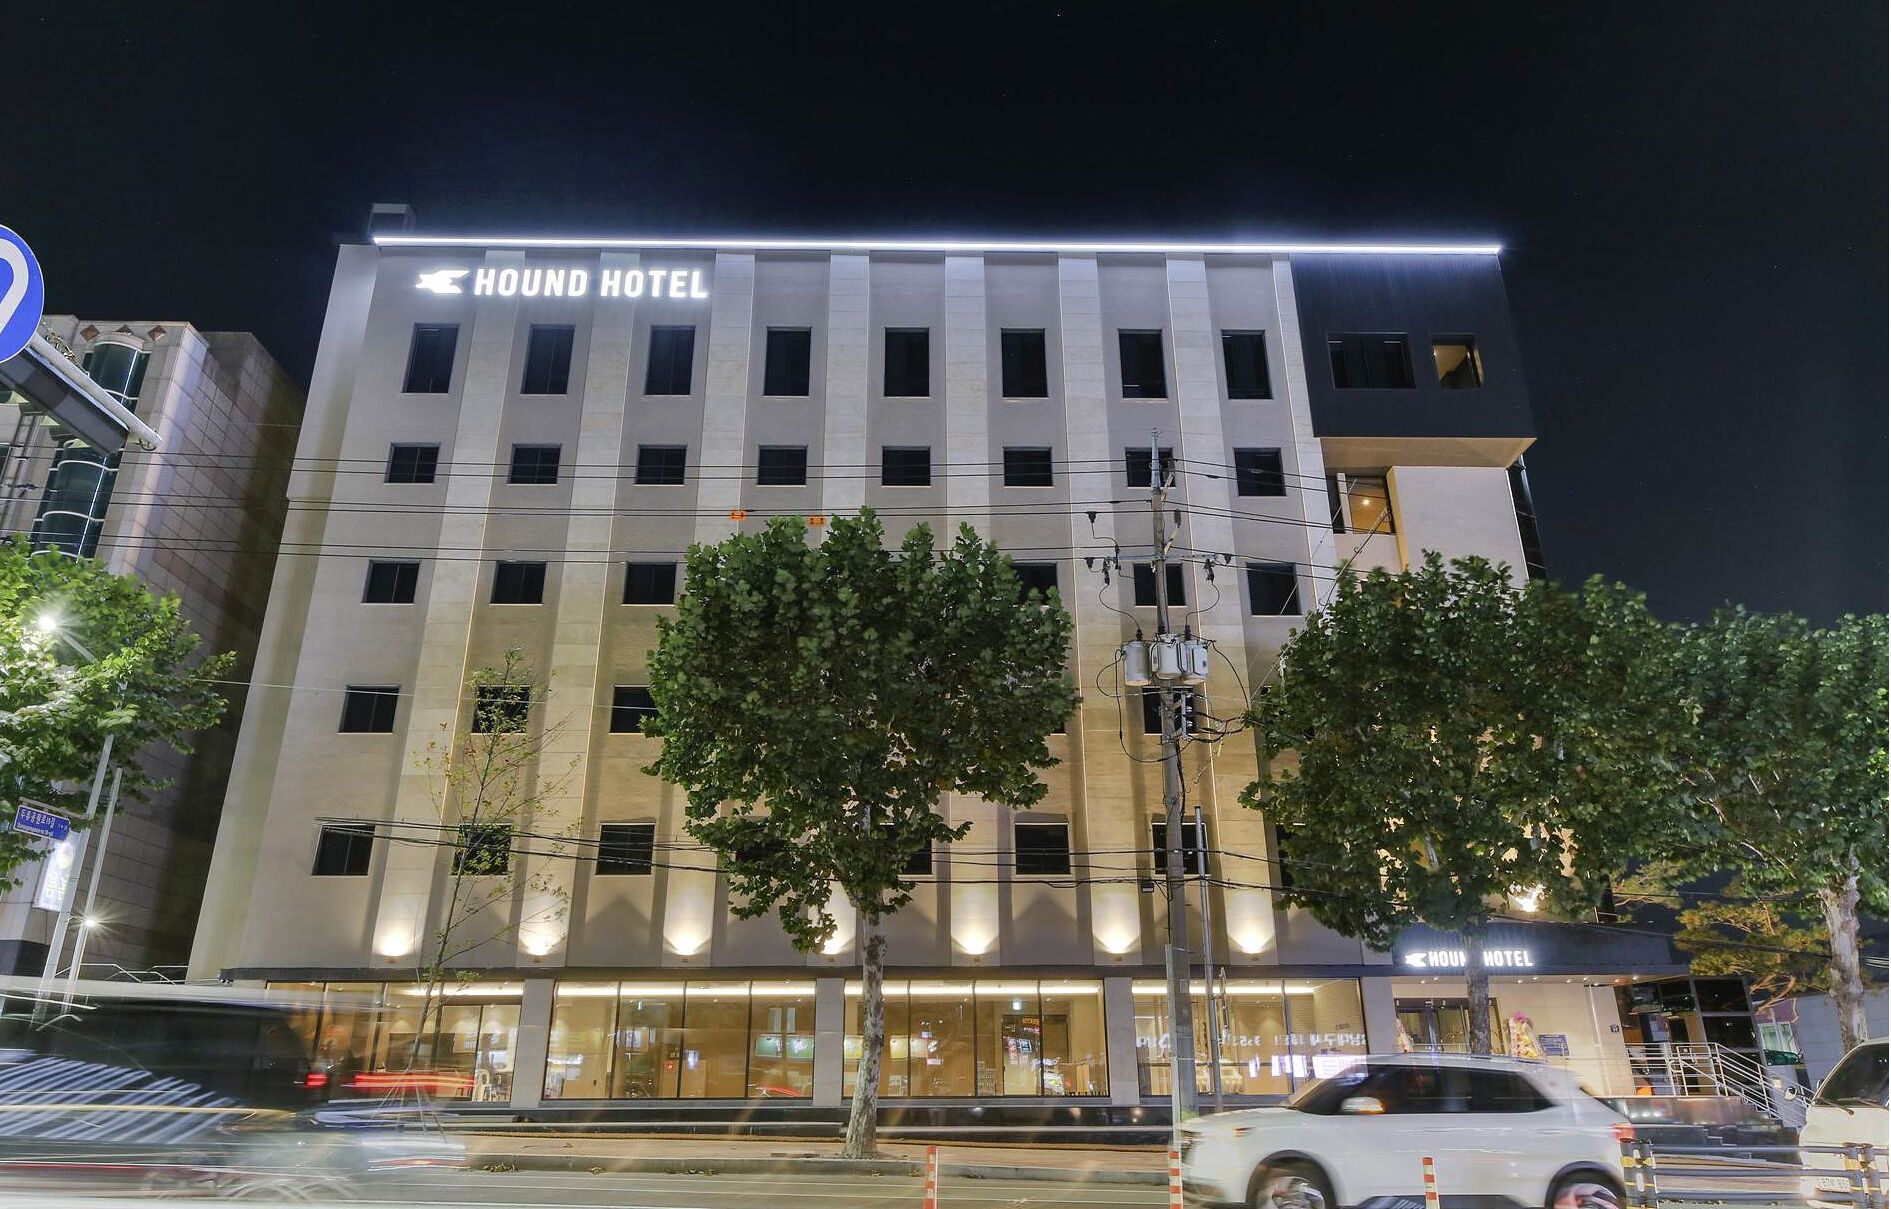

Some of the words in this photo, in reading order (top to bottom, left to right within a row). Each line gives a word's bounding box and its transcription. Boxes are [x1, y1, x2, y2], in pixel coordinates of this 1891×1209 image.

[473, 267, 588, 297] HOUND
[600, 269, 709, 298] HOTEL
[1428, 951, 1467, 967] HOUN
[1483, 950, 1534, 967] HOTEL
